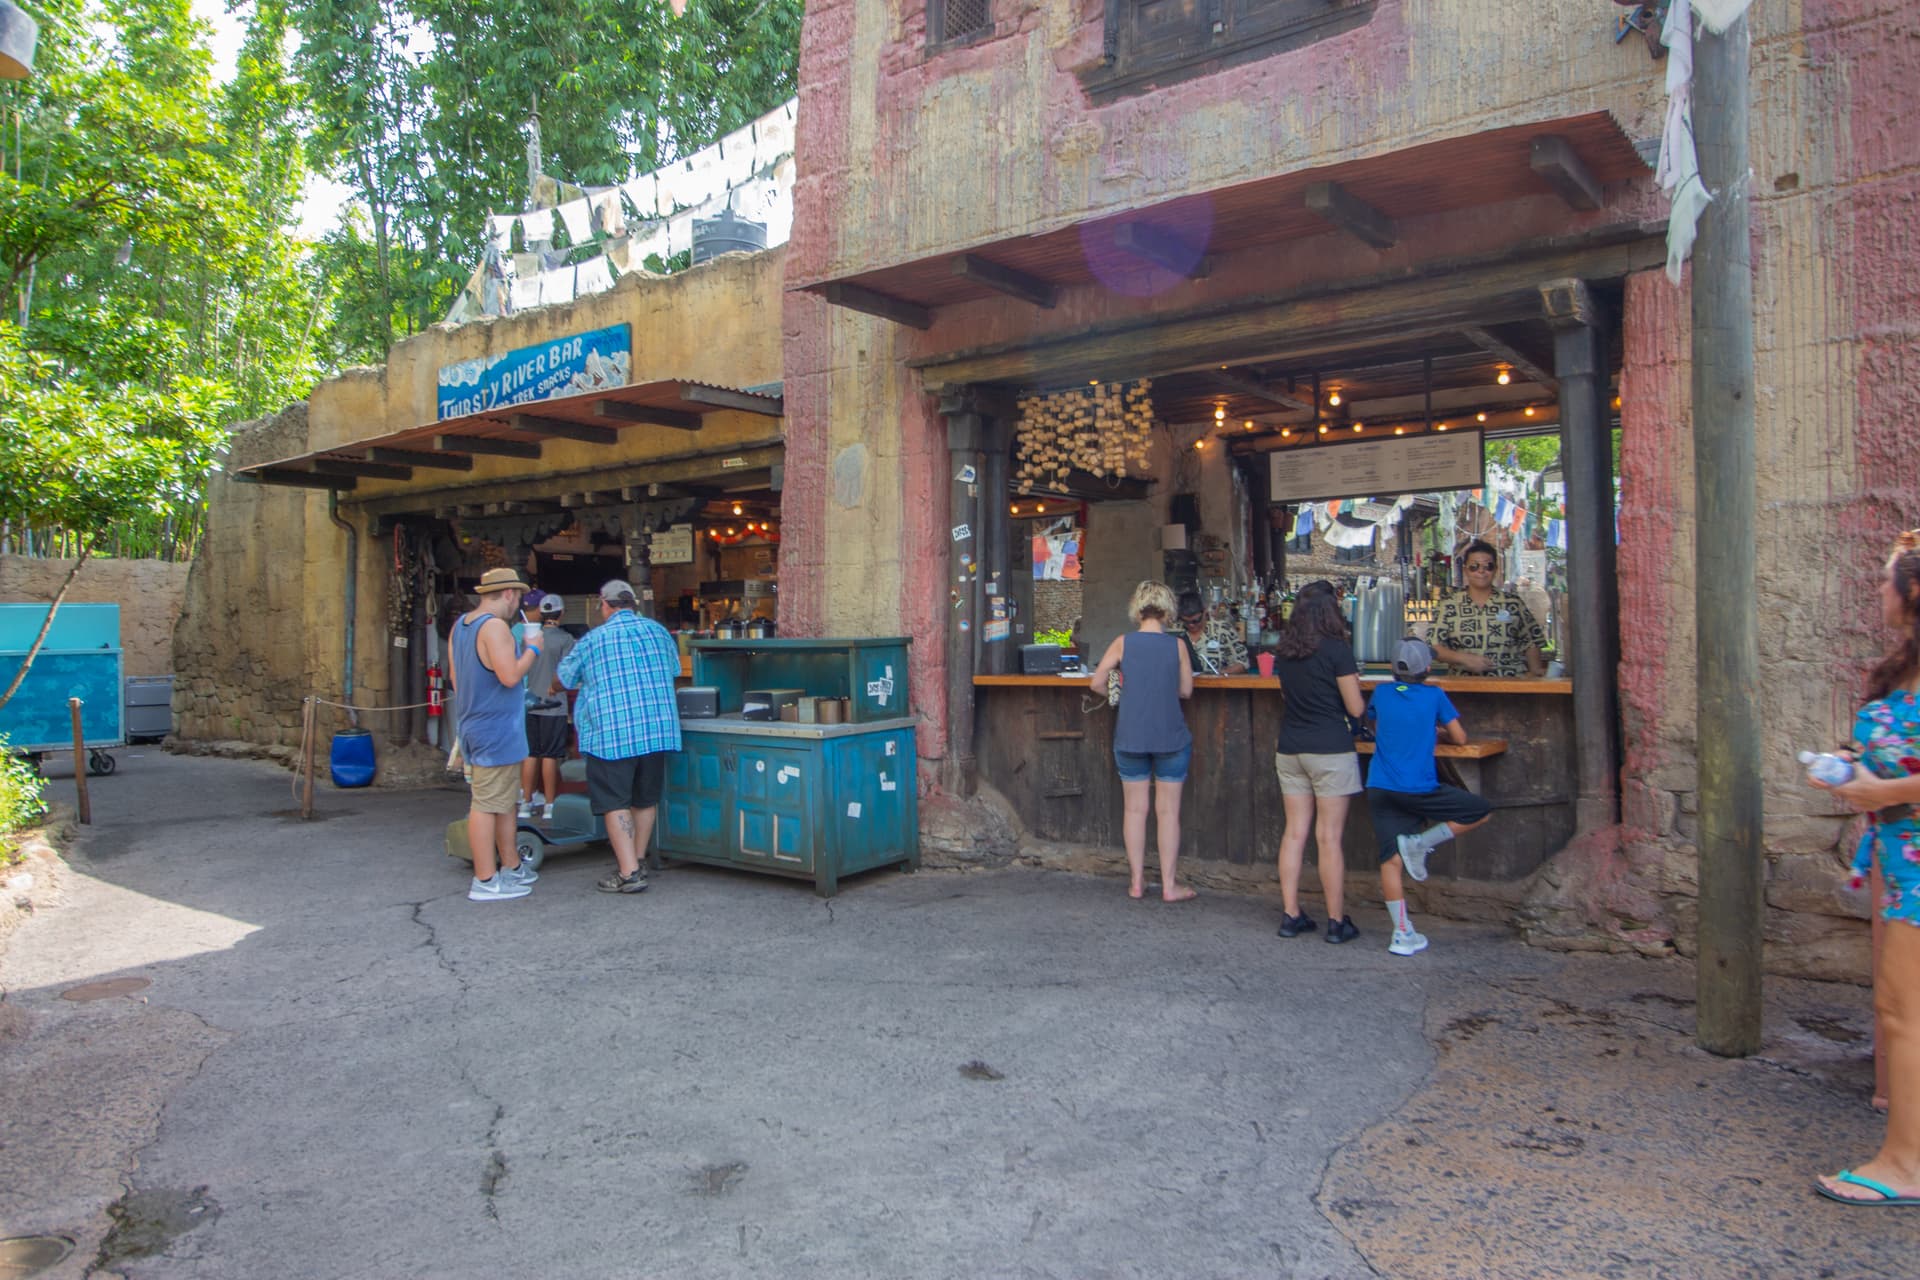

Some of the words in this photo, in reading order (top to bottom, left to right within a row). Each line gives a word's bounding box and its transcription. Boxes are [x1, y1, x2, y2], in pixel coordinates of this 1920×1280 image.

[440, 380, 499, 419] THIRSTY
[502, 354, 546, 397] RIVER
[549, 337, 583, 370] BAR
[511, 386, 535, 404] TREK
